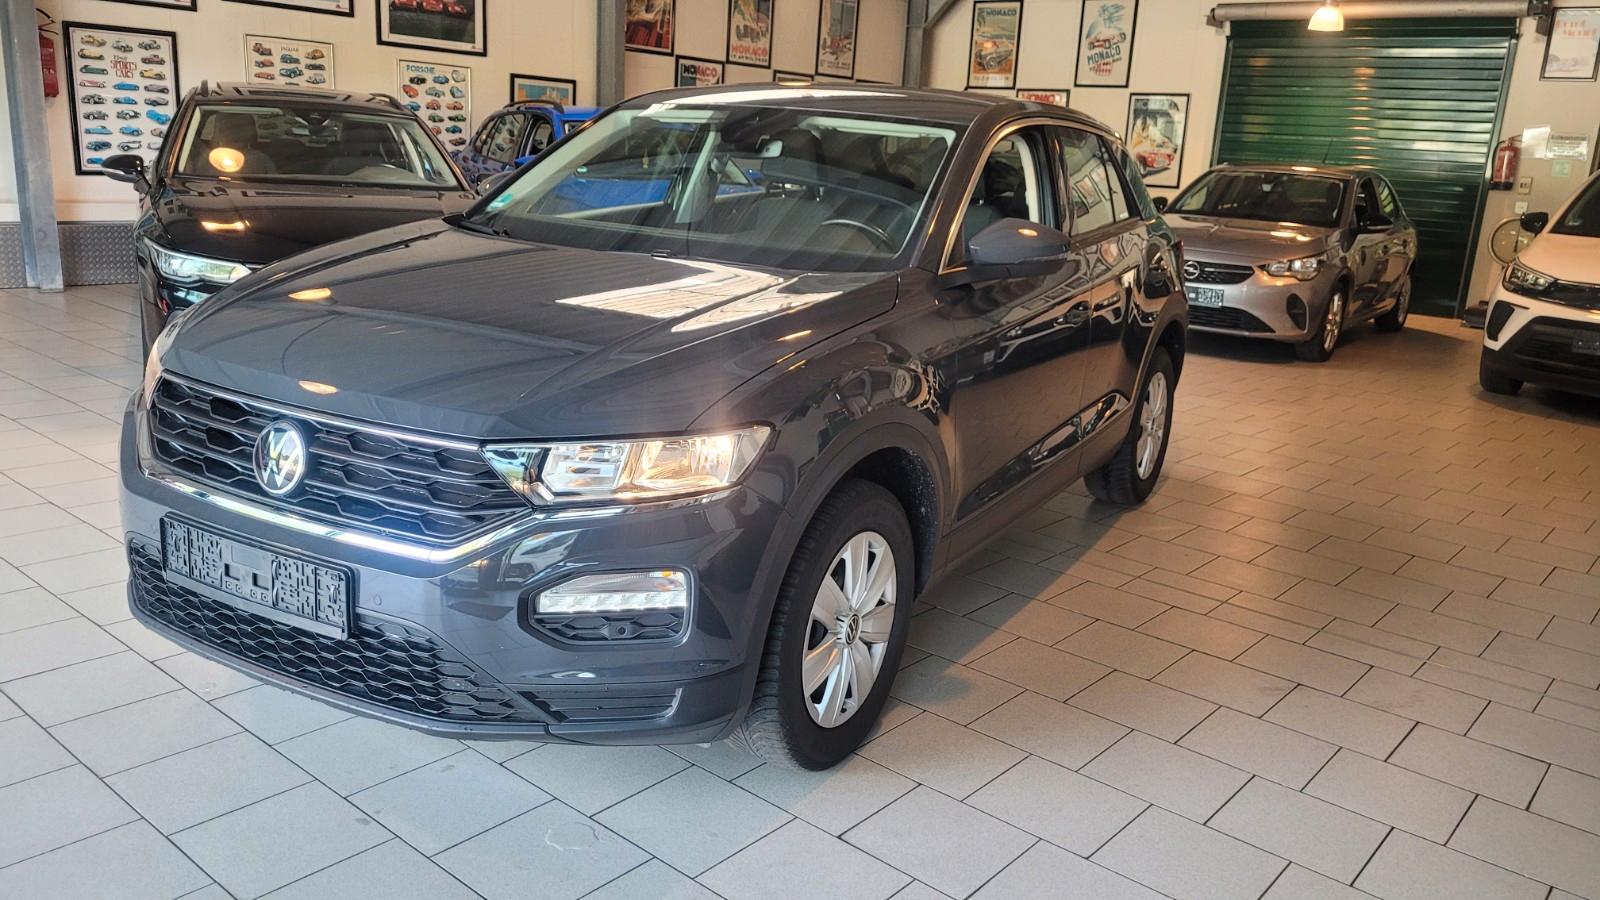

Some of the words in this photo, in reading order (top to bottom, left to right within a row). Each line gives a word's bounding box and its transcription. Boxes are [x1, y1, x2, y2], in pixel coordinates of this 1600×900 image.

[732, 43, 768, 57] MONACO
[1087, 45, 1121, 65] MONACO
[683, 64, 718, 78] MONACO
